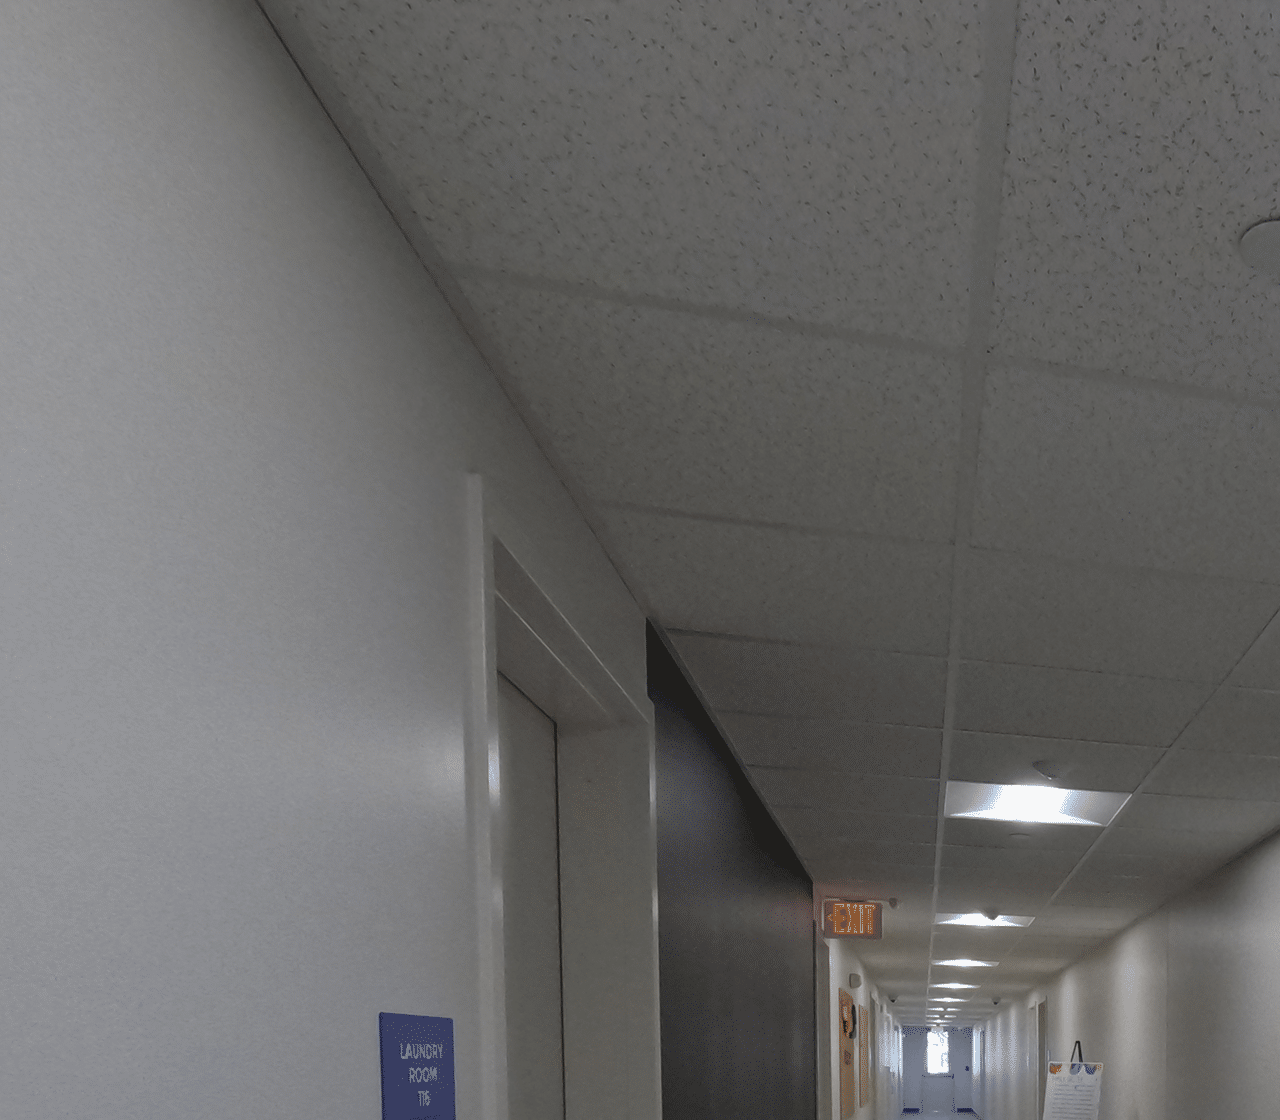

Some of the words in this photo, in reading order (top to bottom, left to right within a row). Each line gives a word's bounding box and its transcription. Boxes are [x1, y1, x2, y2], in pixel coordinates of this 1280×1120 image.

[833, 903, 877, 934] EXIT
[400, 1043, 443, 1059] LAUNDRY
[408, 1066, 438, 1083] ROOM
